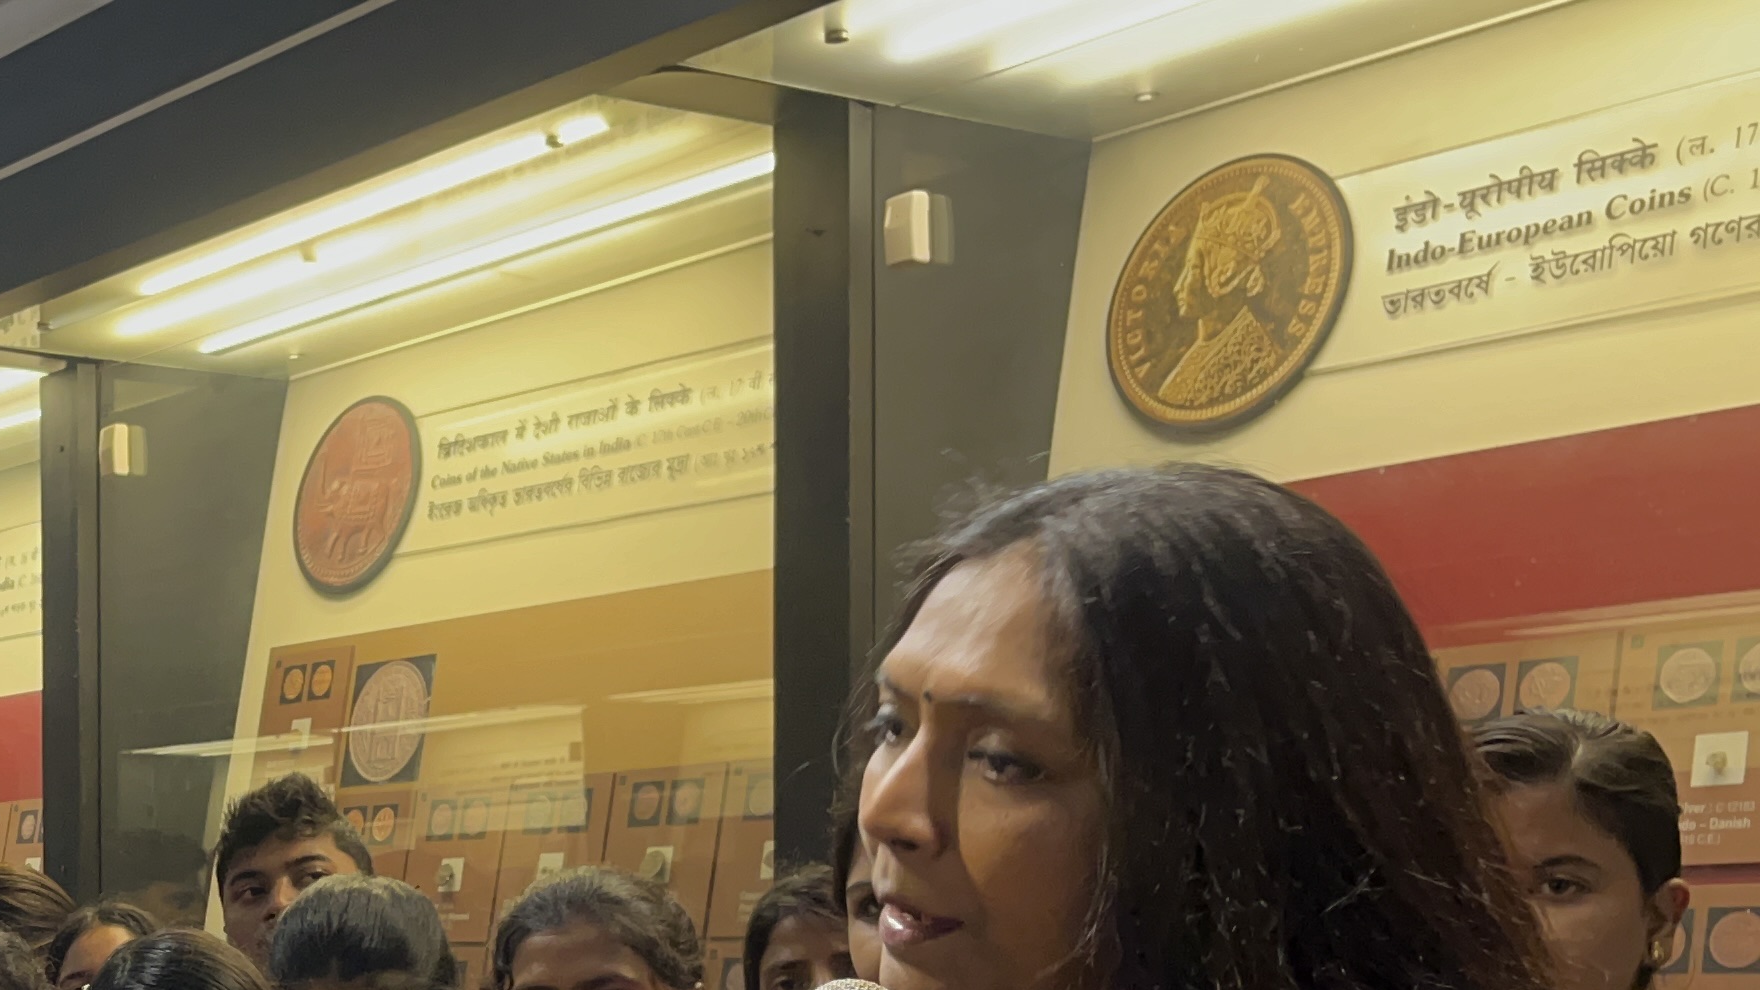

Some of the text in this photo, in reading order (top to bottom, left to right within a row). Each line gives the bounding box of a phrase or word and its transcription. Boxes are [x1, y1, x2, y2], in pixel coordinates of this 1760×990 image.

[1394, 166, 1558, 232] इंडो-यूरोपीय
[1574, 137, 1658, 184] सिक्के
[1385, 209, 1593, 275] Indo-European
[1604, 185, 1692, 221] Coins
[1703, 174, 1735, 203] (C.
[1126, 224, 1187, 378] VICTORIA
[1287, 193, 1330, 337] EMPRESS
[1381, 261, 1500, 318] ভারতবর্ষে
[515, 419, 527, 439] में
[624, 394, 640, 416] के
[648, 383, 692, 412] सिक्के
[431, 473, 462, 491] Coins
[466, 468, 478, 483] of
[480, 463, 497, 480] the
[501, 458, 538, 476] Native
[542, 448, 580, 467] States
[583, 444, 594, 459] in
[599, 436, 631, 456] India
[1709, 816, 1751, 830] Danish
